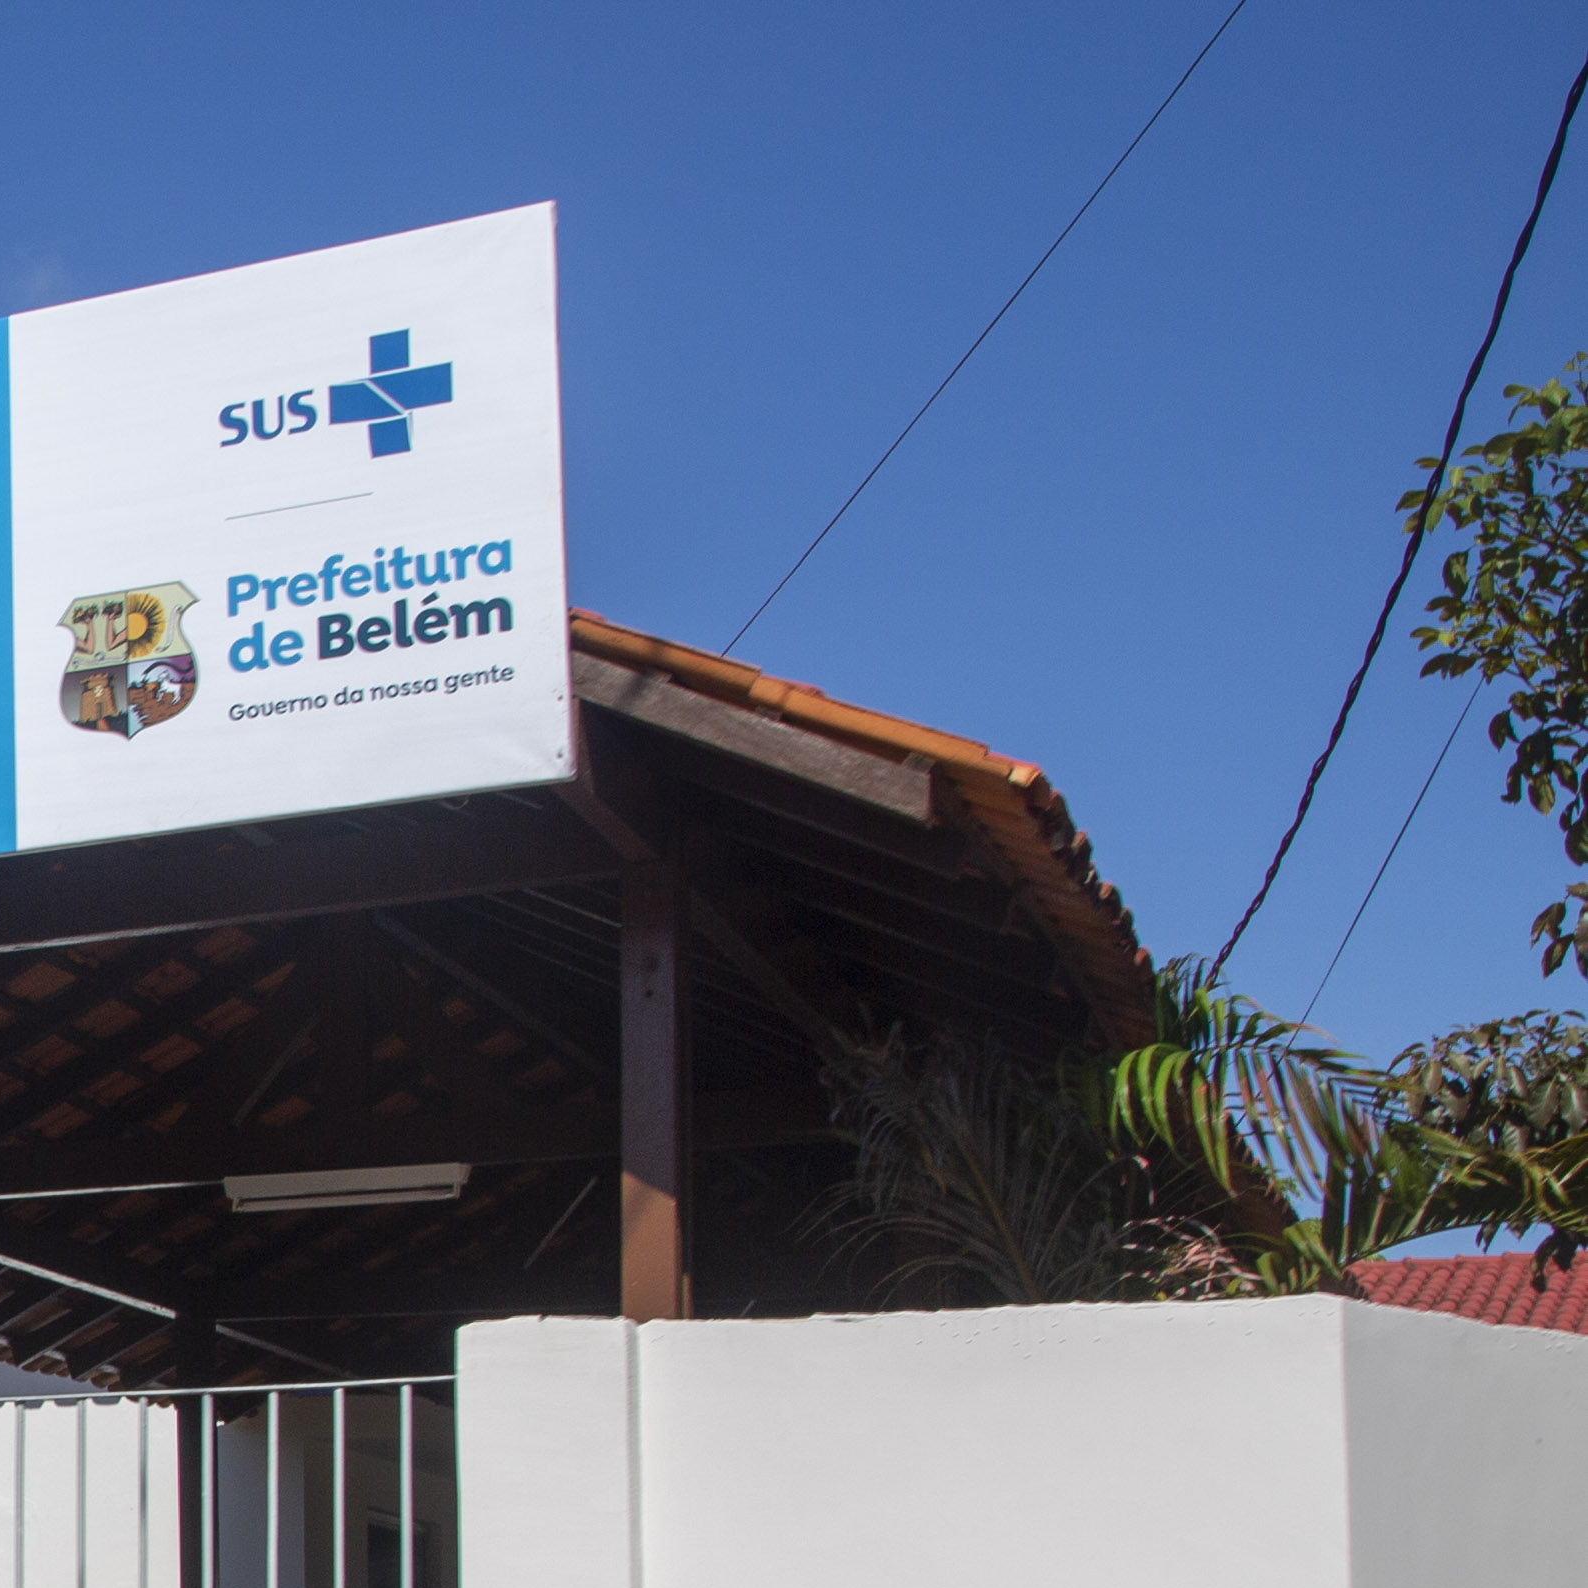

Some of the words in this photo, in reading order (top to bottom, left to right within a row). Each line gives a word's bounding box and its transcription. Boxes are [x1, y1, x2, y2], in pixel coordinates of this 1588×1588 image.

[218, 389, 318, 447] SUS
[227, 538, 513, 617] Prefeitura
[228, 621, 304, 673] de
[317, 591, 514, 661] Belém
[228, 694, 328, 722] Governo
[333, 686, 364, 706] da
[369, 677, 438, 702] nossa
[444, 664, 515, 695] gente
